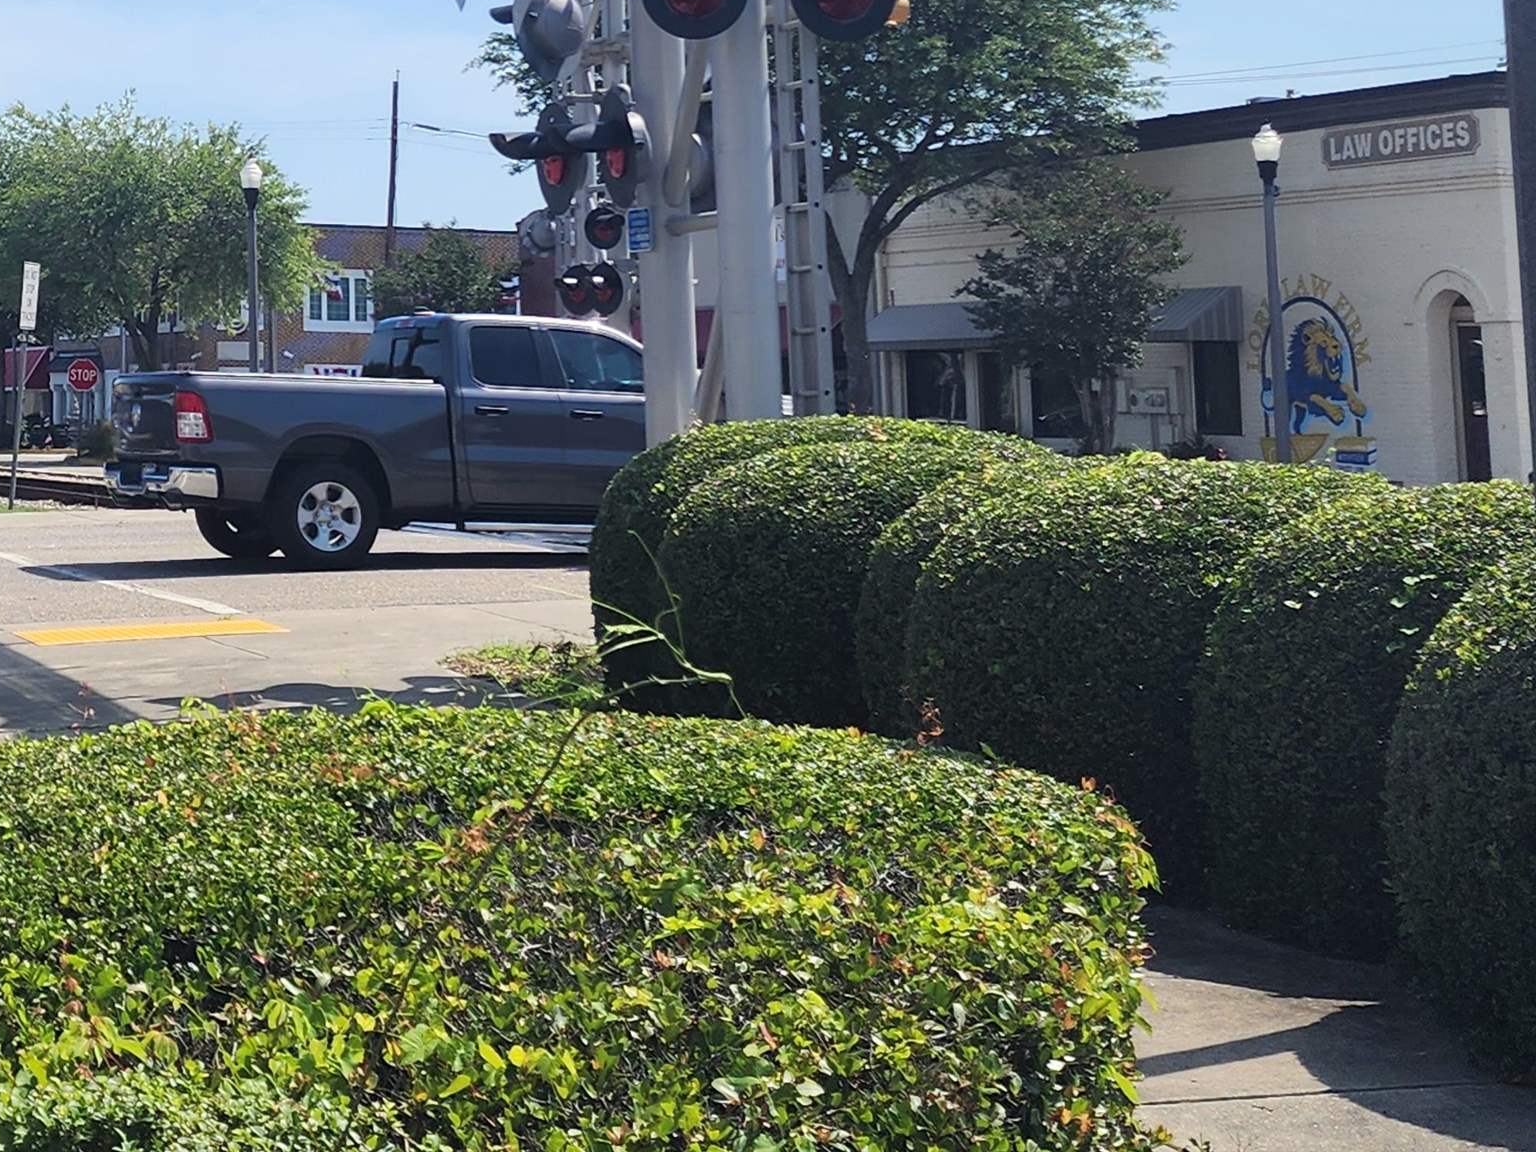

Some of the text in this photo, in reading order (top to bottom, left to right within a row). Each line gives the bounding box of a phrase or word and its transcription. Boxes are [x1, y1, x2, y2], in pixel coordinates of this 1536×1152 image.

[1329, 120, 1471, 162] LAW OFFICES
[1281, 273, 1333, 300] LAW
[1333, 289, 1373, 368] FIRM
[70, 368, 97, 382] STOP
